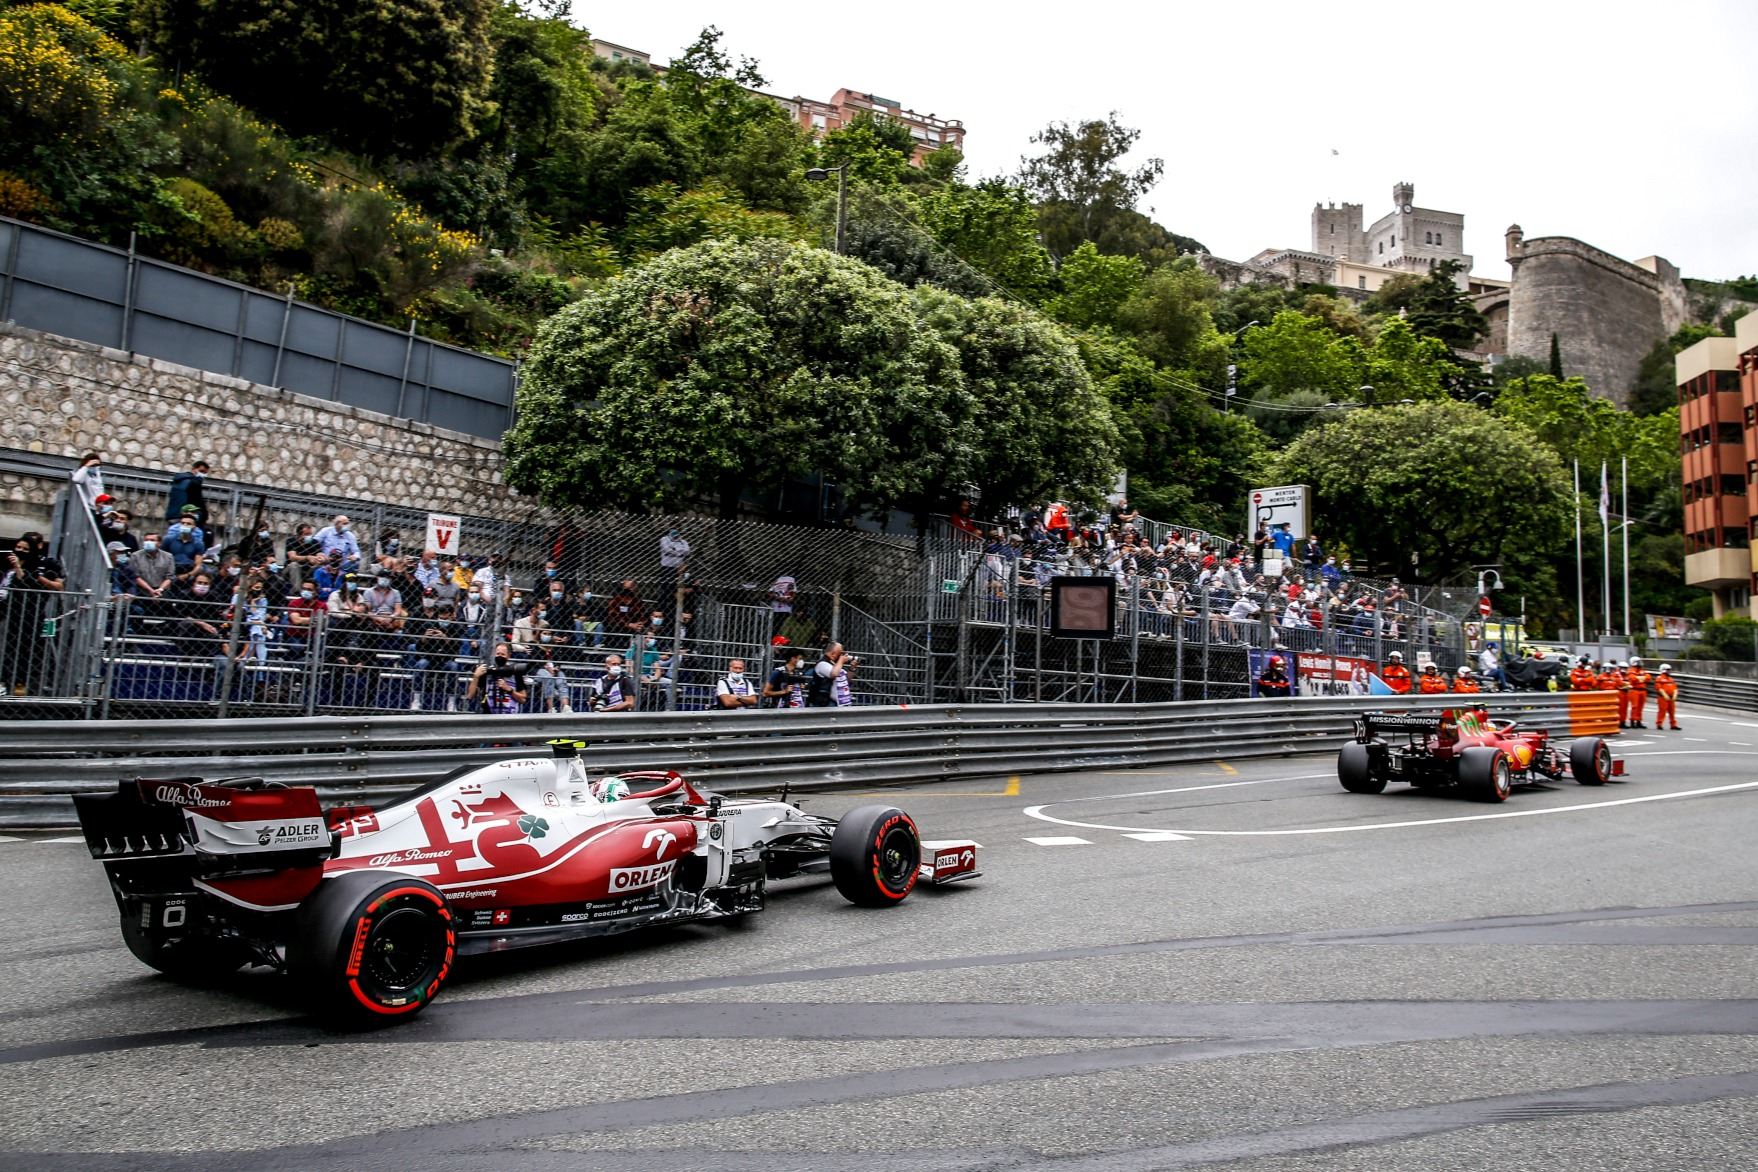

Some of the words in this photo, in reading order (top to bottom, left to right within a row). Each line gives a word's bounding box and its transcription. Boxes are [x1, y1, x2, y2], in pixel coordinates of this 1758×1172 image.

[436, 529, 452, 549] V
[156, 786, 189, 807] Alfa
[275, 837, 297, 845] PELZER
[298, 835, 319, 843] GROUP
[276, 824, 319, 837] ADLER
[875, 815, 899, 849] ZERO
[368, 852, 405, 868] Alfa
[405, 848, 453, 861] Romeo
[937, 855, 958, 868] ORLEN
[614, 864, 672, 889] ORLEN
[443, 891, 464, 900] AUBER
[465, 889, 497, 899] Engineering
[561, 912, 589, 921] sparco
[345, 916, 372, 976] PIRELLI
[427, 929, 455, 999] ZERO
